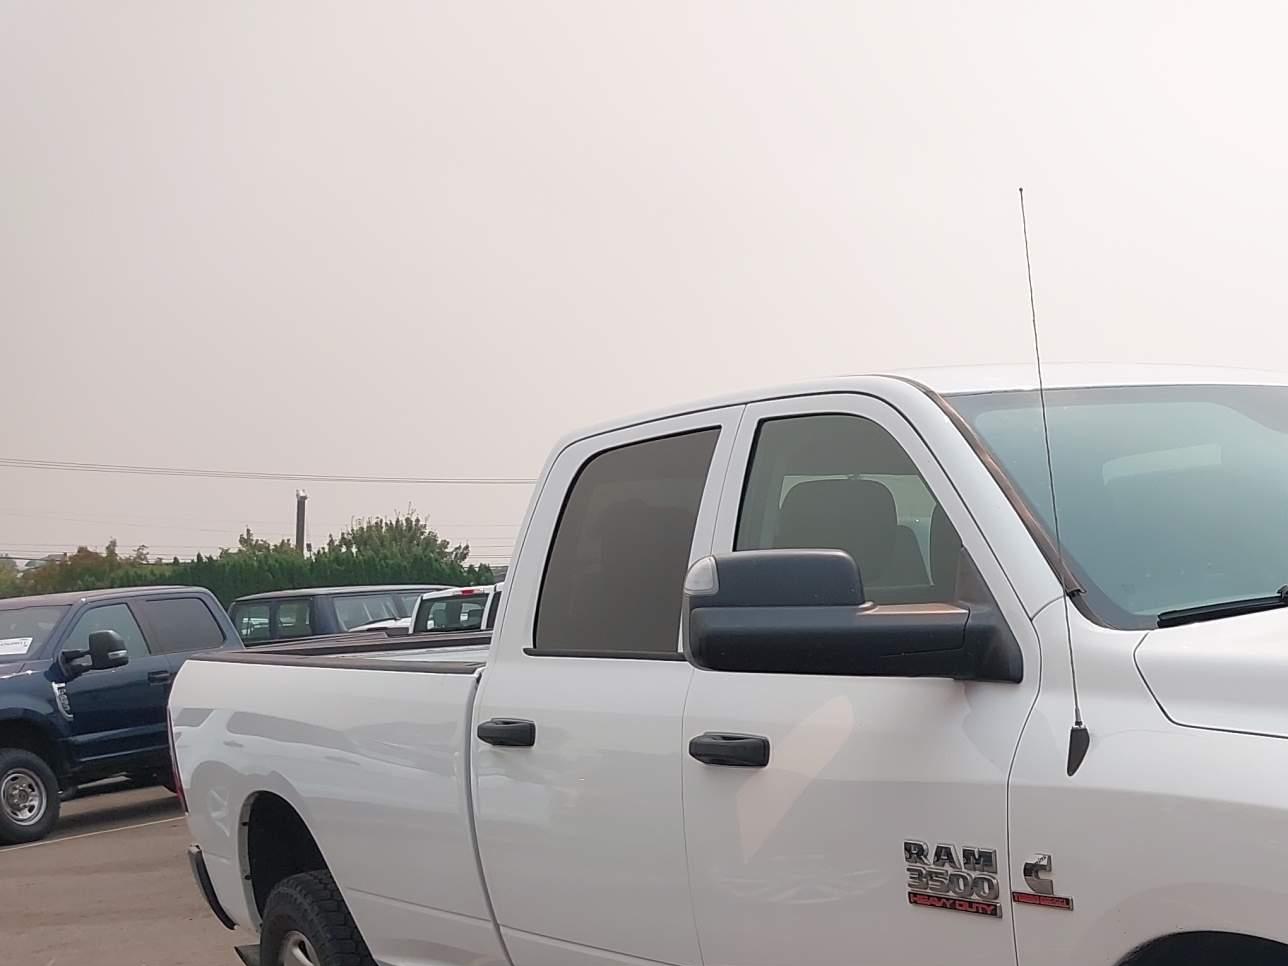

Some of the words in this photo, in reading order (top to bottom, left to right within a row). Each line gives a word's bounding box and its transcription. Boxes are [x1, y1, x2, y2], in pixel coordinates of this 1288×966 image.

[903, 838, 998, 874] RAM
[906, 865, 1000, 901] 3500
[911, 893, 954, 909] HEAVY
[955, 900, 993, 914] DUTY
